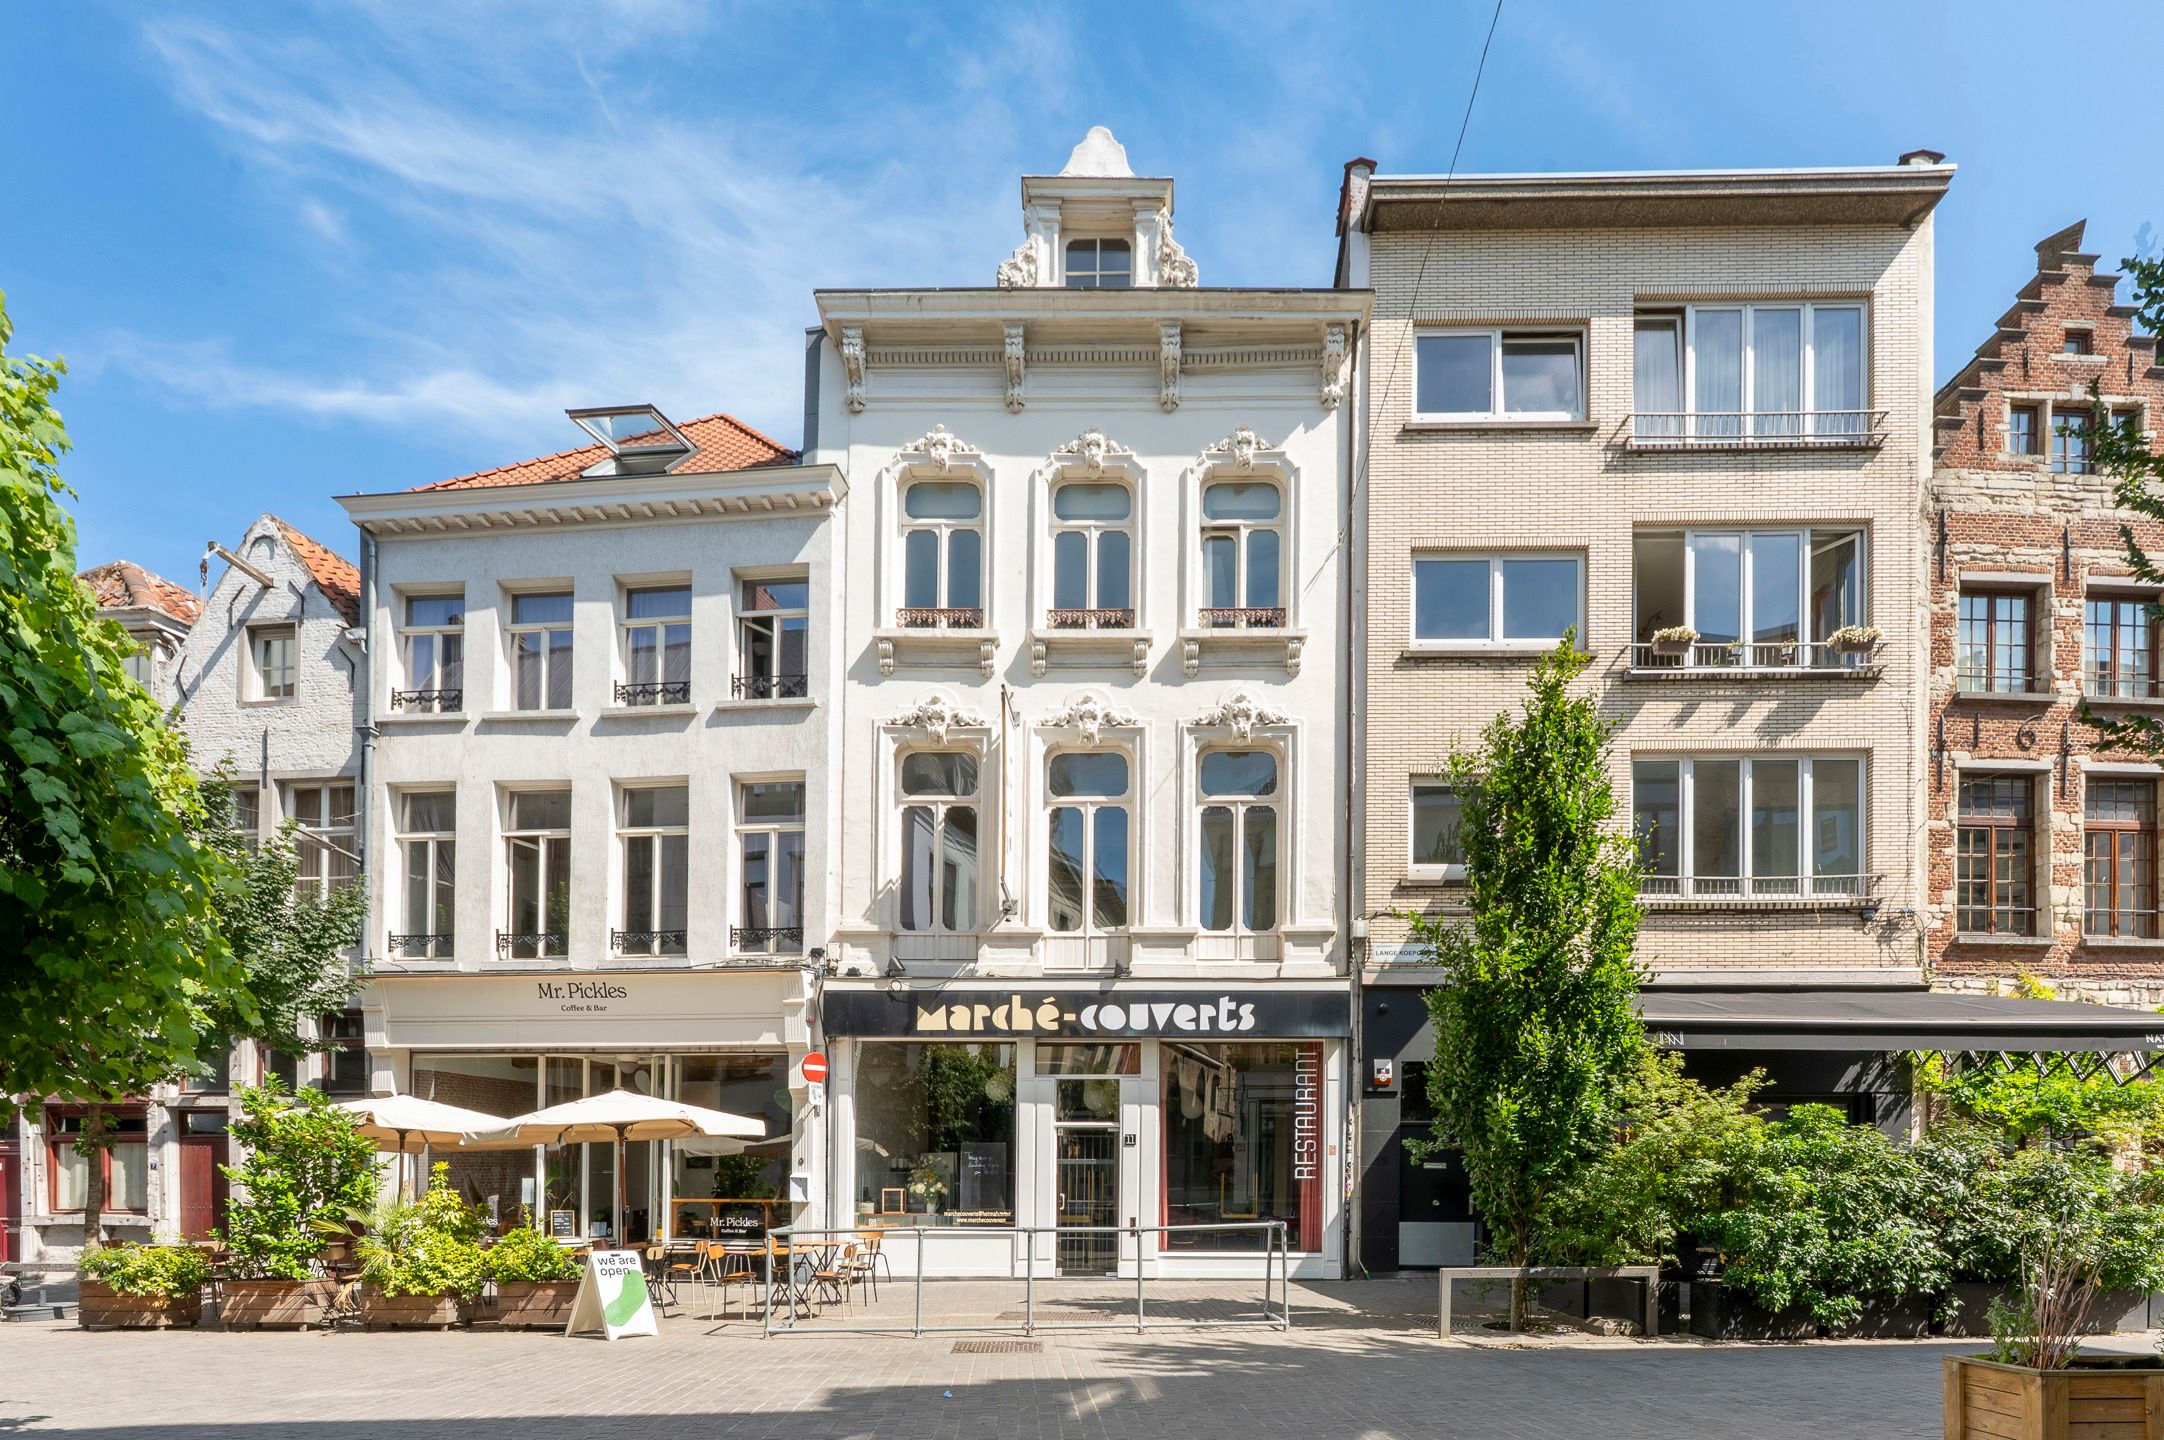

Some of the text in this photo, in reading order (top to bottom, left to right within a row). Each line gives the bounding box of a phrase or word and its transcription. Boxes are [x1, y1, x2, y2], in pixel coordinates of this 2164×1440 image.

[538, 982, 627, 999] Mr. Pickles
[561, 1004, 607, 1012] Coffee & Bar
[1294, 1048, 1317, 1179] RESTAURANT
[1125, 1135, 1135, 1145] 11
[710, 1217, 759, 1227] Mr. Pickles
[598, 1257, 636, 1265] we are
[600, 1267, 630, 1278] open
